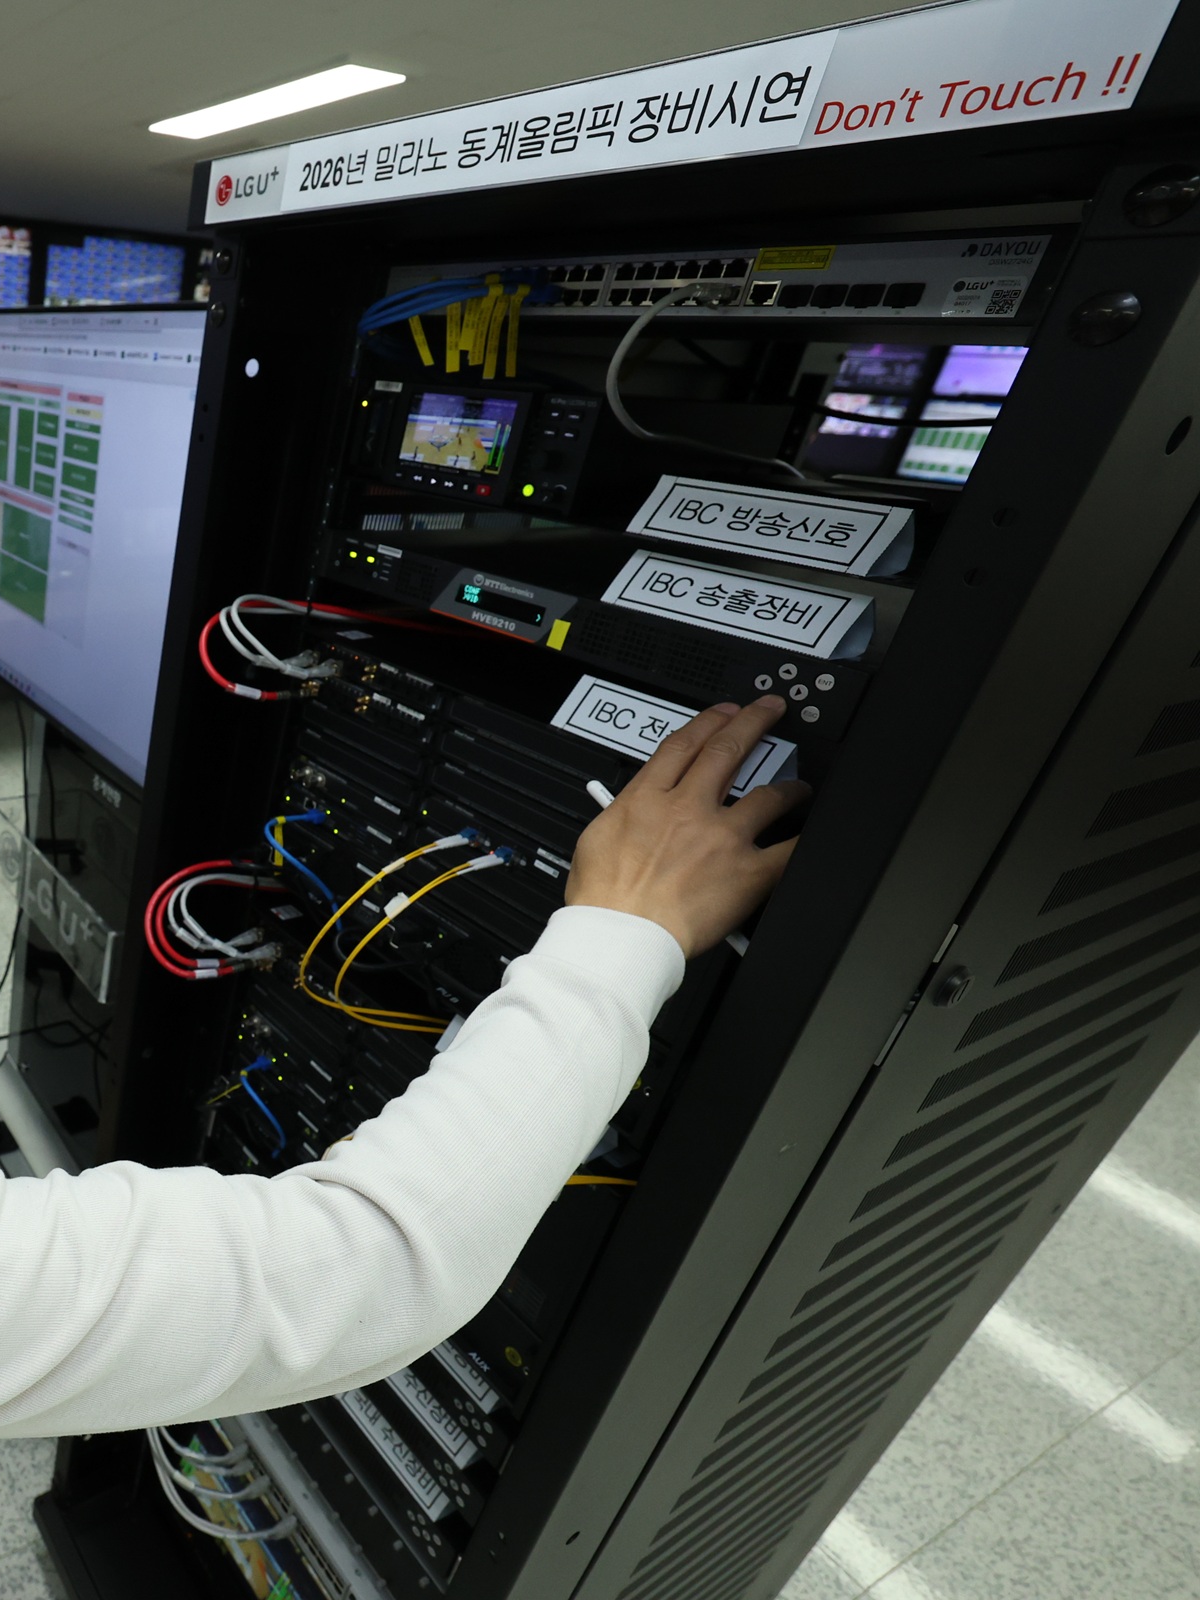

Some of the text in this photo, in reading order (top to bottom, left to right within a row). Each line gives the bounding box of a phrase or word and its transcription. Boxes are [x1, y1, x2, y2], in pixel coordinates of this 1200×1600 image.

[813, 88, 924, 135] Don't
[938, 61, 1087, 119] Touch
[299, 65, 813, 192] 2026년 밀라노 동계올림픽 장비시연
[980, 241, 1041, 257] DAYOU
[668, 497, 858, 548] IBC 방송신호
[642, 570, 823, 630] IBC 송출장비
[471, 610, 516, 632] HVE9210
[817, 678, 833, 687] ENT
[588, 699, 636, 730] IBC
[467, 1352, 491, 1373] AUX
